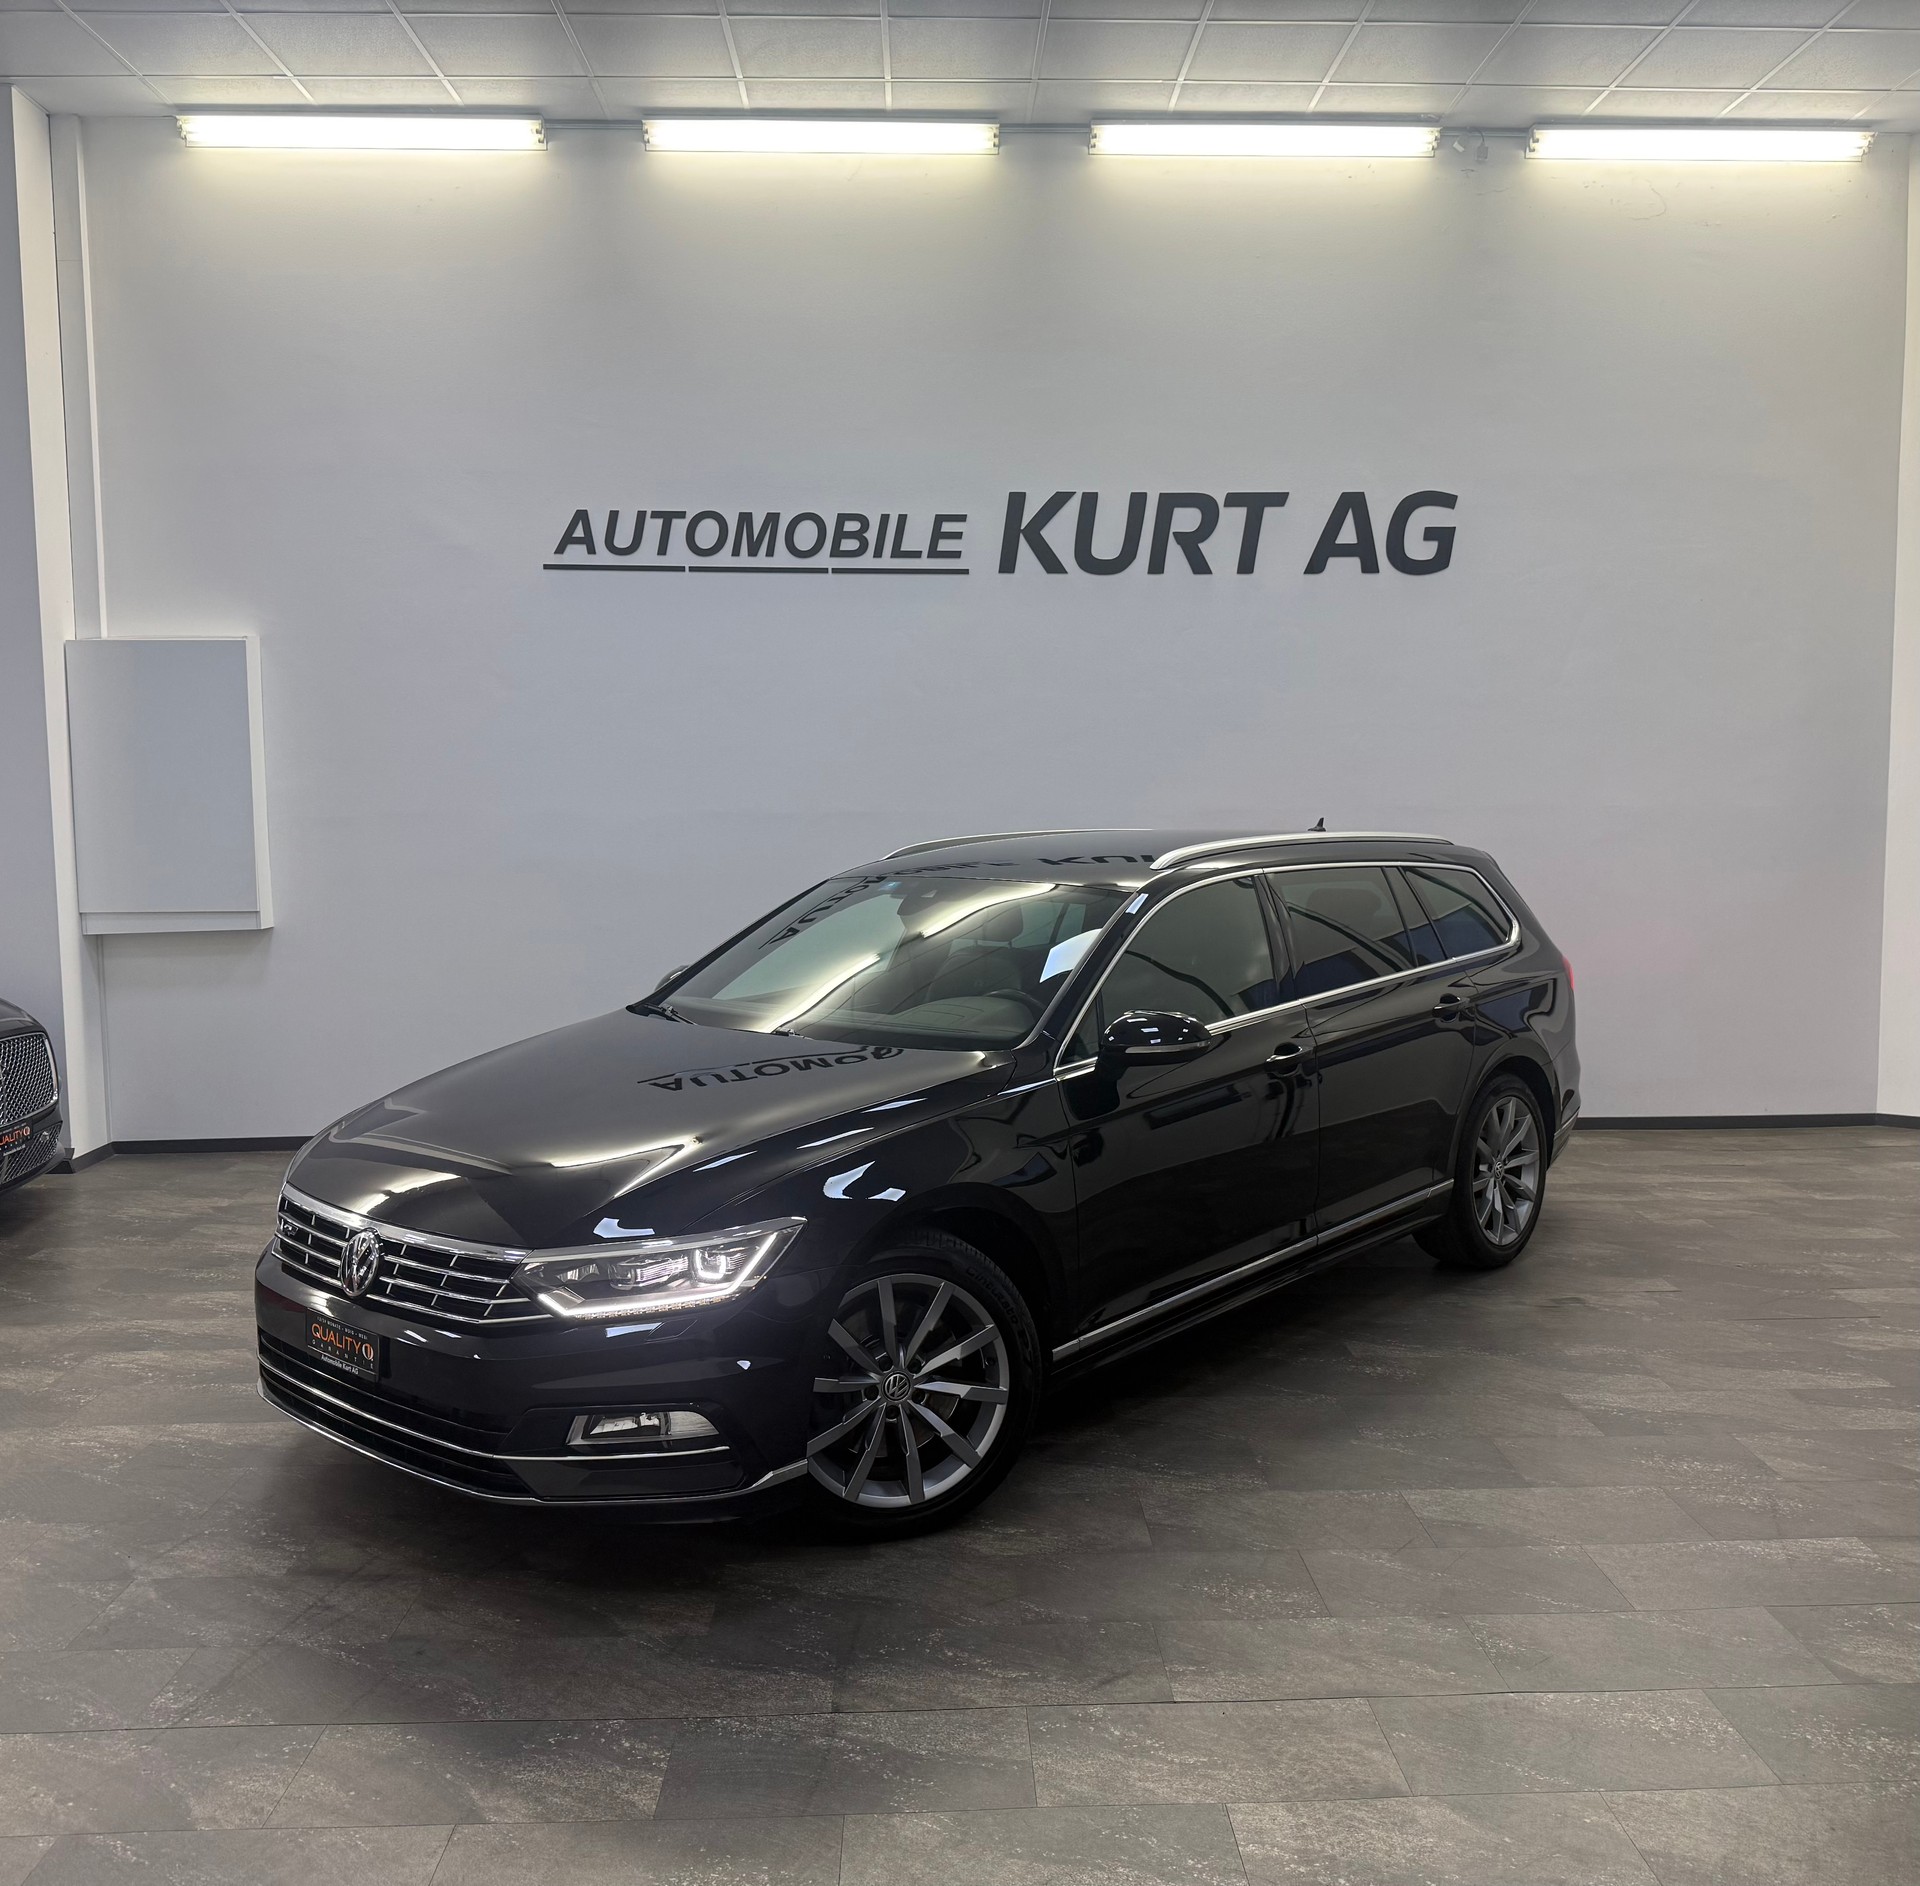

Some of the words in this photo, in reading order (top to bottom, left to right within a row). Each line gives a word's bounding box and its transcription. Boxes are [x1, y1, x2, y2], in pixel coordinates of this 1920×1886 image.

[553, 509, 968, 559] AUTOMOBILE
[998, 491, 1290, 576] KURT
[1303, 490, 1459, 576] AG
[311, 1323, 361, 1354] QUALITY
[311, 1339, 374, 1370] GARANTIE
[320, 1354, 343, 1368] Automobile
